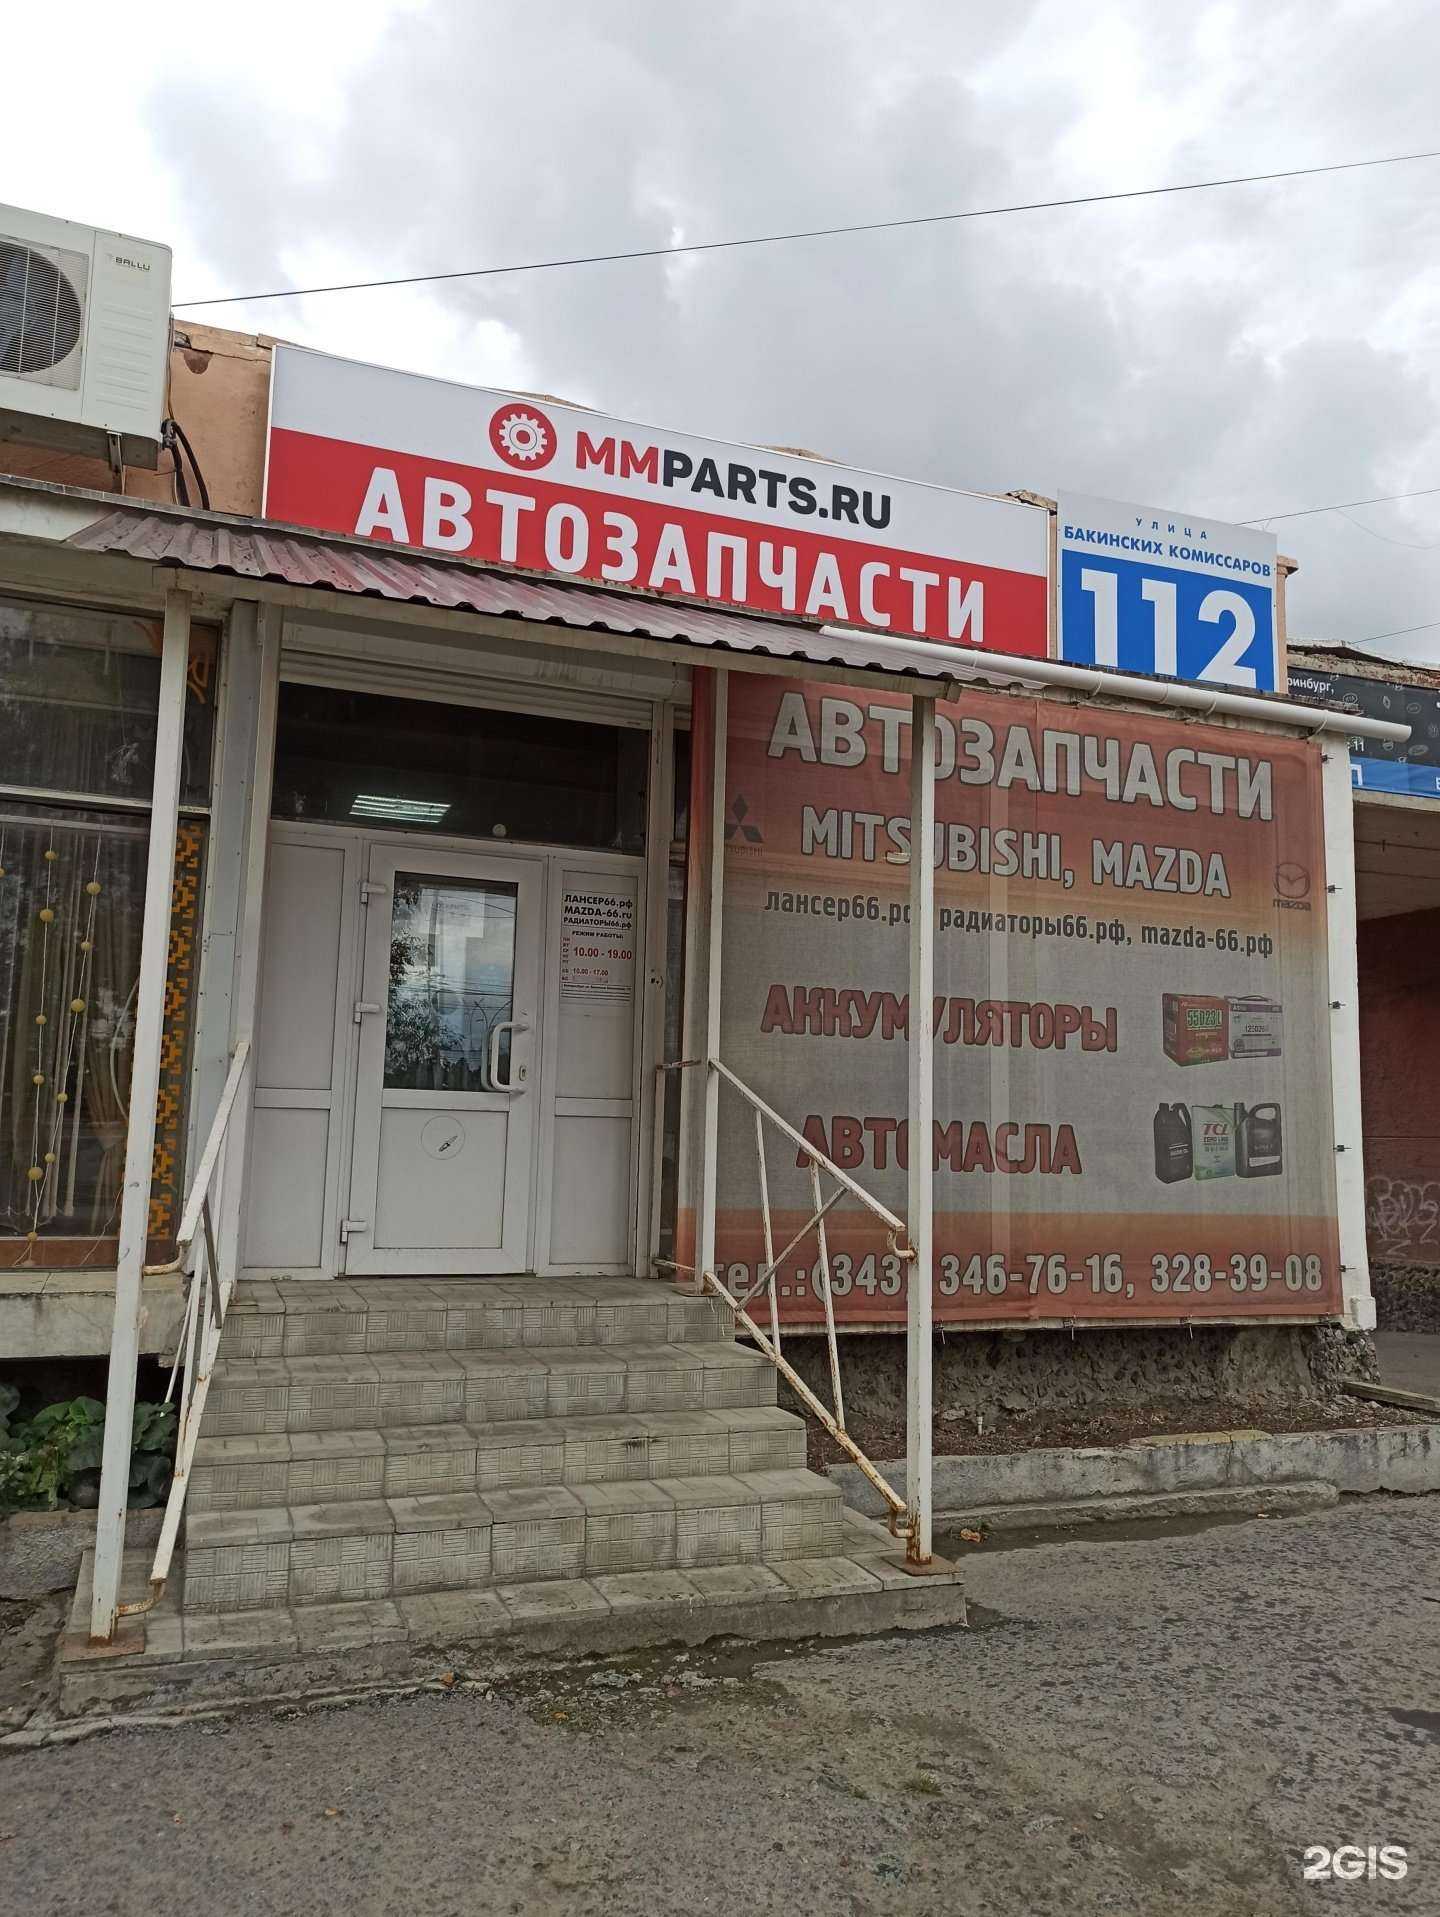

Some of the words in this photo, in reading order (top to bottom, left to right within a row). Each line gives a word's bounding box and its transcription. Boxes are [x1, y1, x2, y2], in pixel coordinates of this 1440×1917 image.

[115, 256, 151, 271] BALLU
[575, 430, 892, 530] MMPARTS.RU
[354, 466, 985, 643] АВТОЗАПЧАСТИ
[1063, 525, 1163, 556] БАКИНСКИХ
[1169, 544, 1272, 577] КОМИССАРОВ
[1080, 567, 1257, 691] 112
[1287, 678, 1334, 694] ринбург,
[1091, 837, 1231, 899] MAZDA
[563, 916, 632, 929] РАДИАТОРЫ66.рф
[564, 894, 633, 909] ЛАНСЕР66.рф
[564, 905, 632, 920] MAZDA-66.ru
[574, 946, 599, 957] 10.00
[607, 948, 632, 960] 19.00
[939, 906, 1132, 947] радиаторы66.рф,
[1141, 922, 1273, 959] mazda-66.рф
[939, 1253, 1135, 1300] 346-76-16,
[1150, 1253, 1324, 1294] 328-39-08
